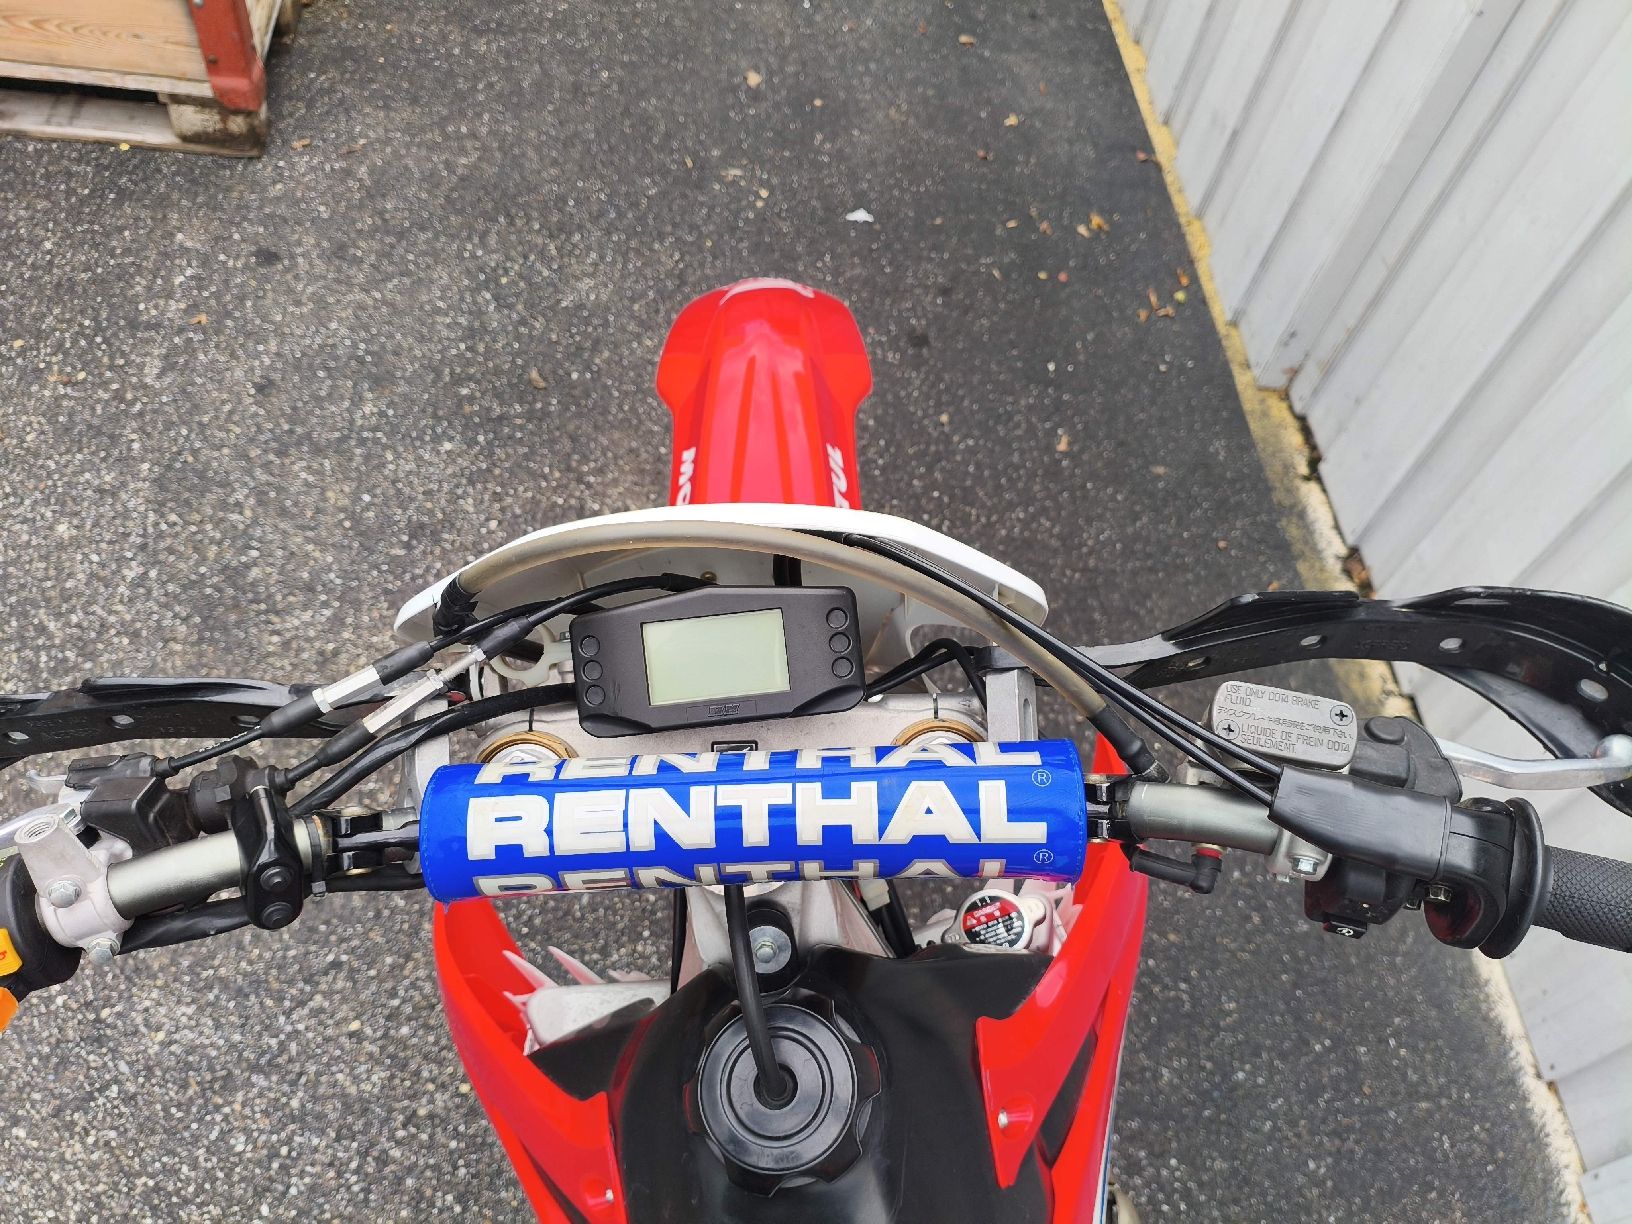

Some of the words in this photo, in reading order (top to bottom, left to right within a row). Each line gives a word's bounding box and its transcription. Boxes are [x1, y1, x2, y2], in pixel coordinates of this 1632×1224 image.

[1226, 684, 1242, 695] USE
[1246, 686, 1265, 699] ONLY
[1268, 691, 1289, 703] DOT4
[1292, 695, 1320, 710] BRAKE
[1241, 723, 1277, 739] LIQUIDE
[1281, 730, 1293, 742] DE
[1297, 733, 1324, 747] FREIN
[1327, 739, 1350, 753] DOT4
[467, 781, 1047, 861] RENTHAL
